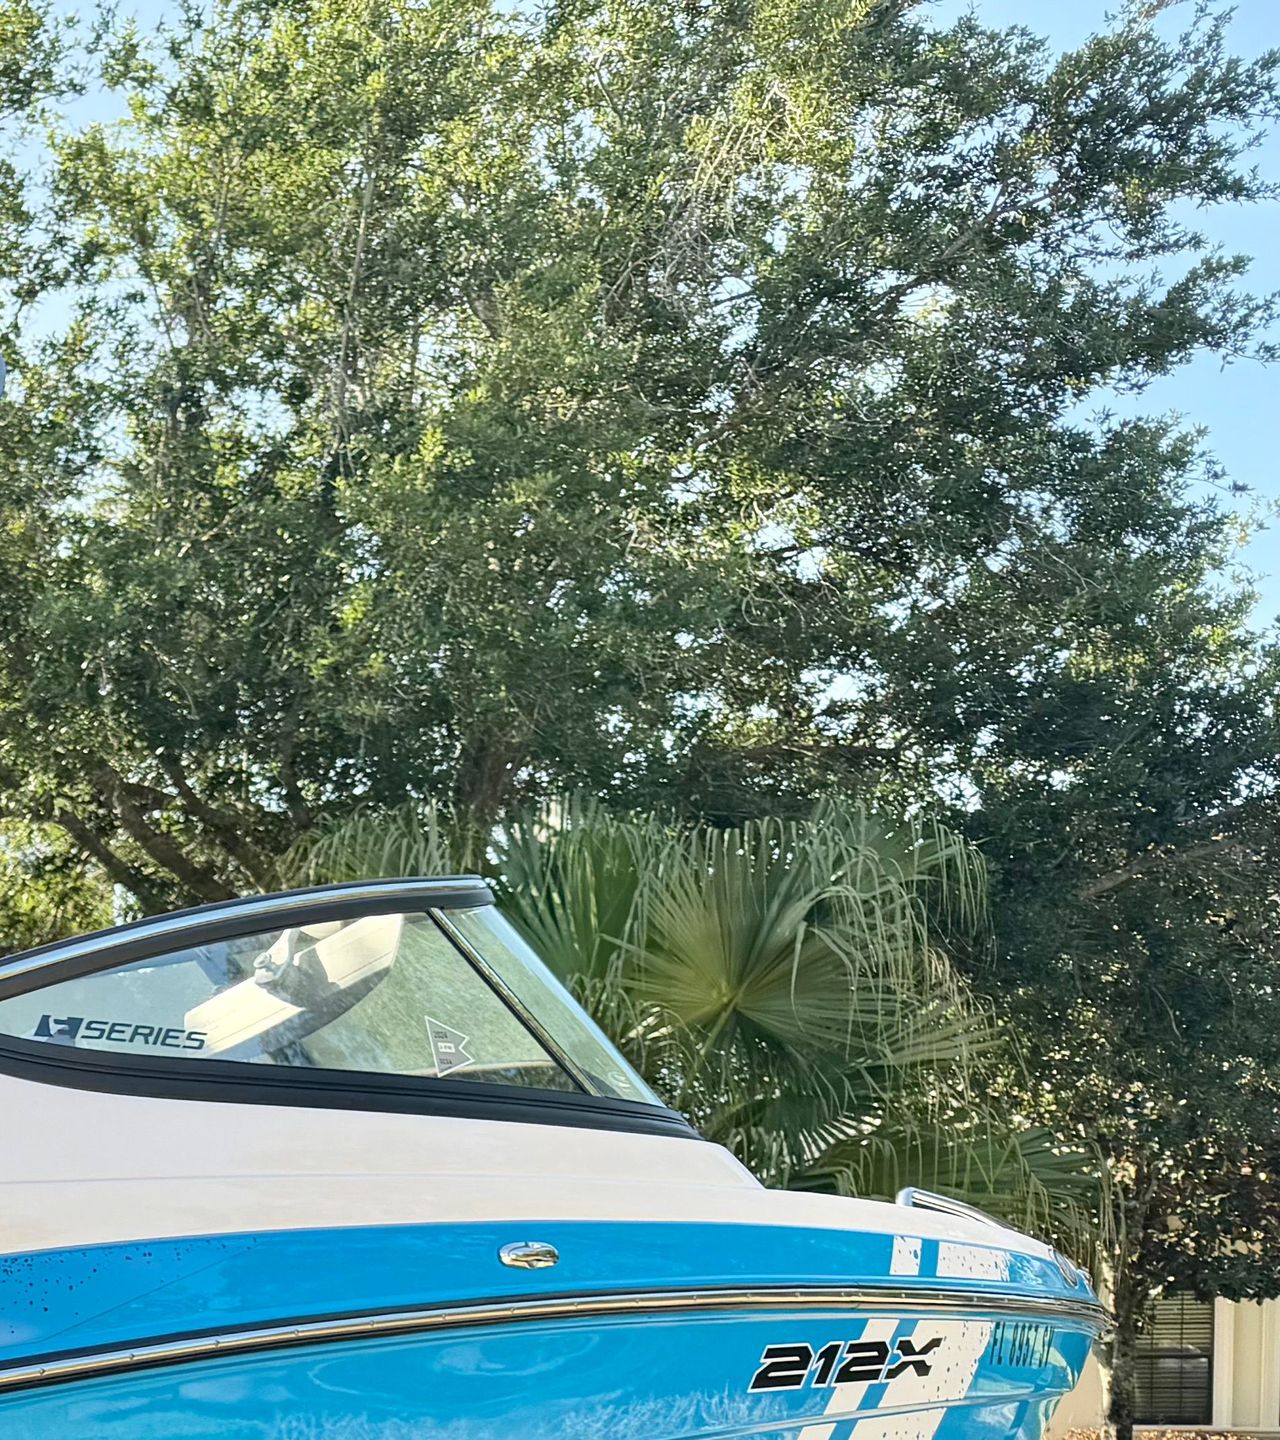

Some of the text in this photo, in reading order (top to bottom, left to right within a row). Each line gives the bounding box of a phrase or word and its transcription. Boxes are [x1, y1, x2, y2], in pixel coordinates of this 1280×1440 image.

[80, 1020, 208, 1050] SERIES
[747, 1336, 944, 1394] 212X
[989, 1321, 1006, 1366] FL
